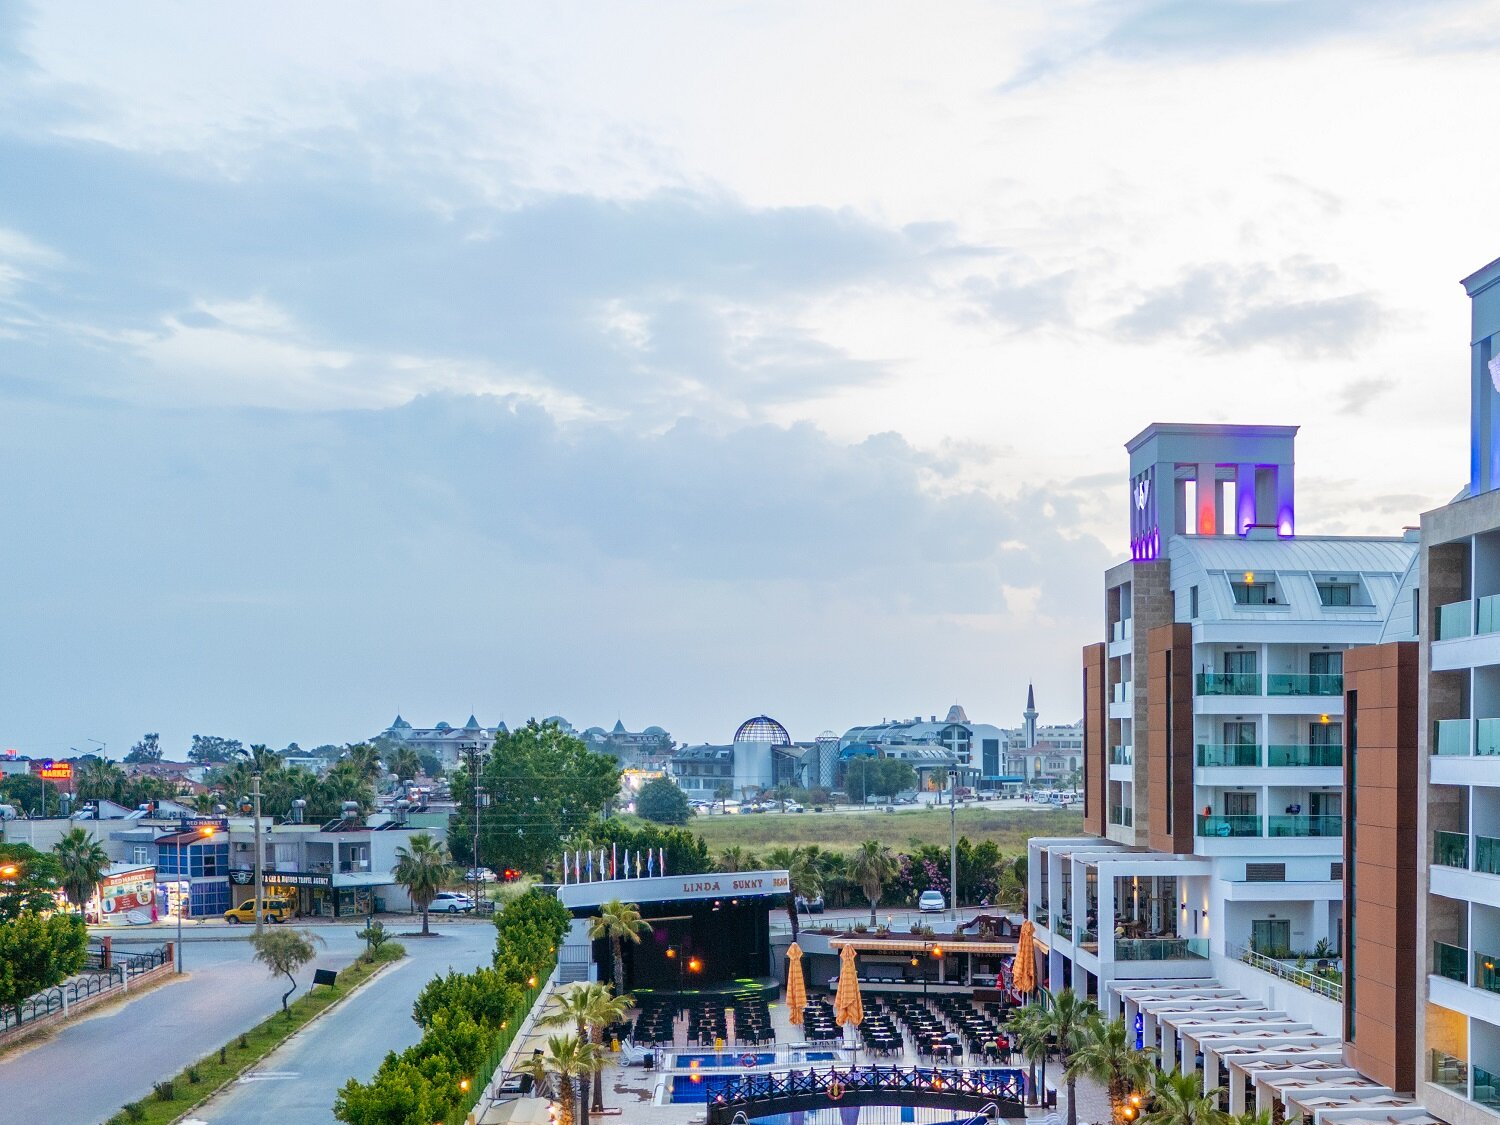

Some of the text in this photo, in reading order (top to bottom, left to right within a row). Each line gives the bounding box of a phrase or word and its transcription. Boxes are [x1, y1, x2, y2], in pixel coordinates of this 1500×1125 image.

[313, 877, 329, 885] AGENCY
[683, 882, 720, 892] LINDA
[733, 879, 763, 890] SUNNY
